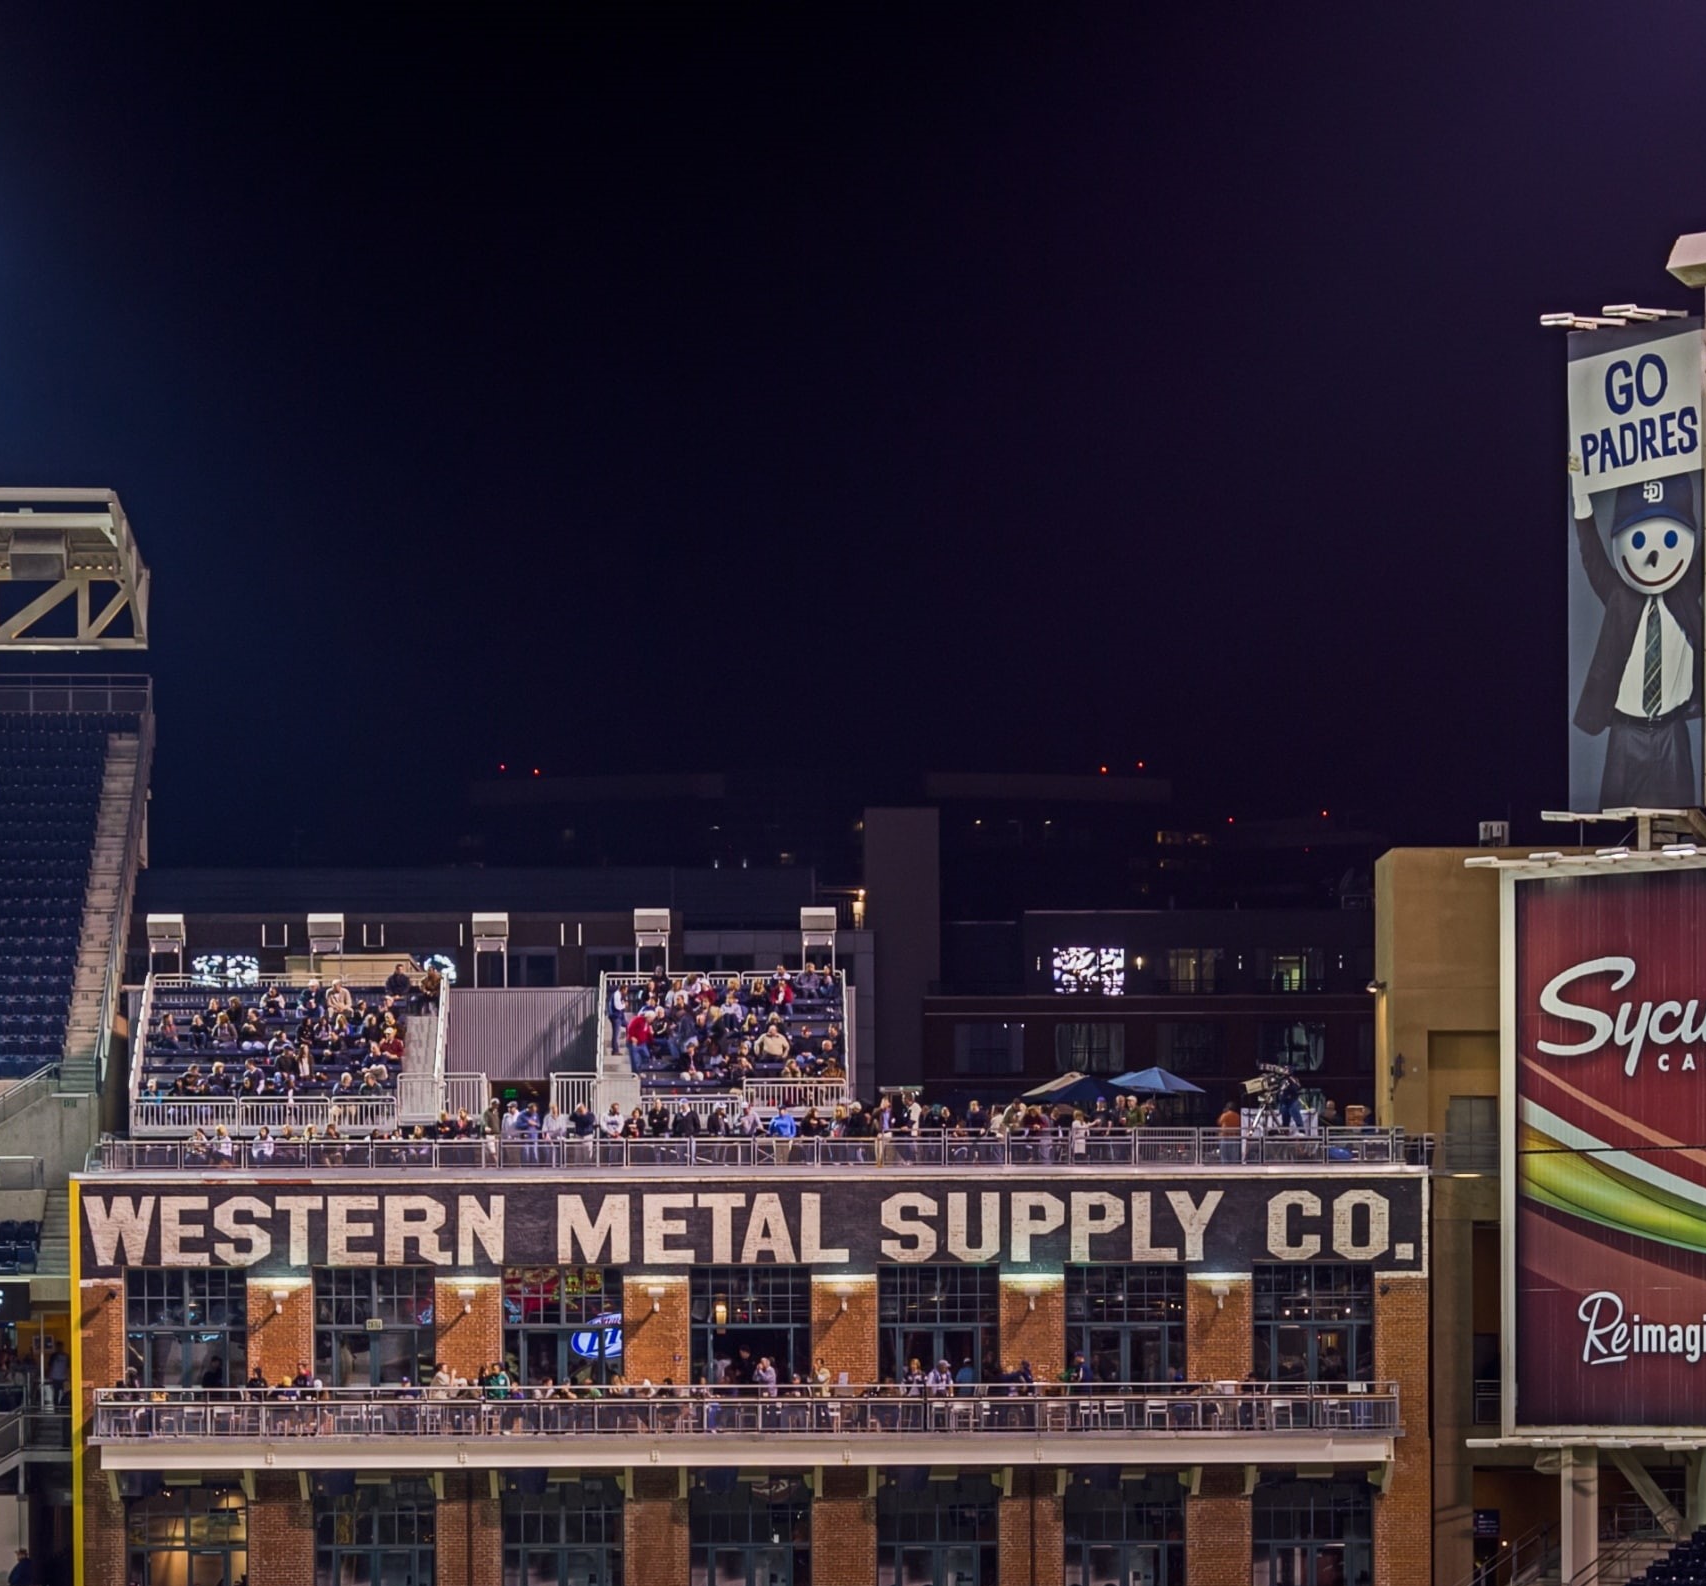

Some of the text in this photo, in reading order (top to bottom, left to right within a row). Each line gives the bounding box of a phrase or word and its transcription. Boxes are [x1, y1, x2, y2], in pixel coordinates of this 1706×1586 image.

[1605, 353, 1668, 415] GO
[1581, 406, 1698, 476] PADRES
[83, 1188, 1414, 1266] WESTERN METAL SUPPLY CO.
